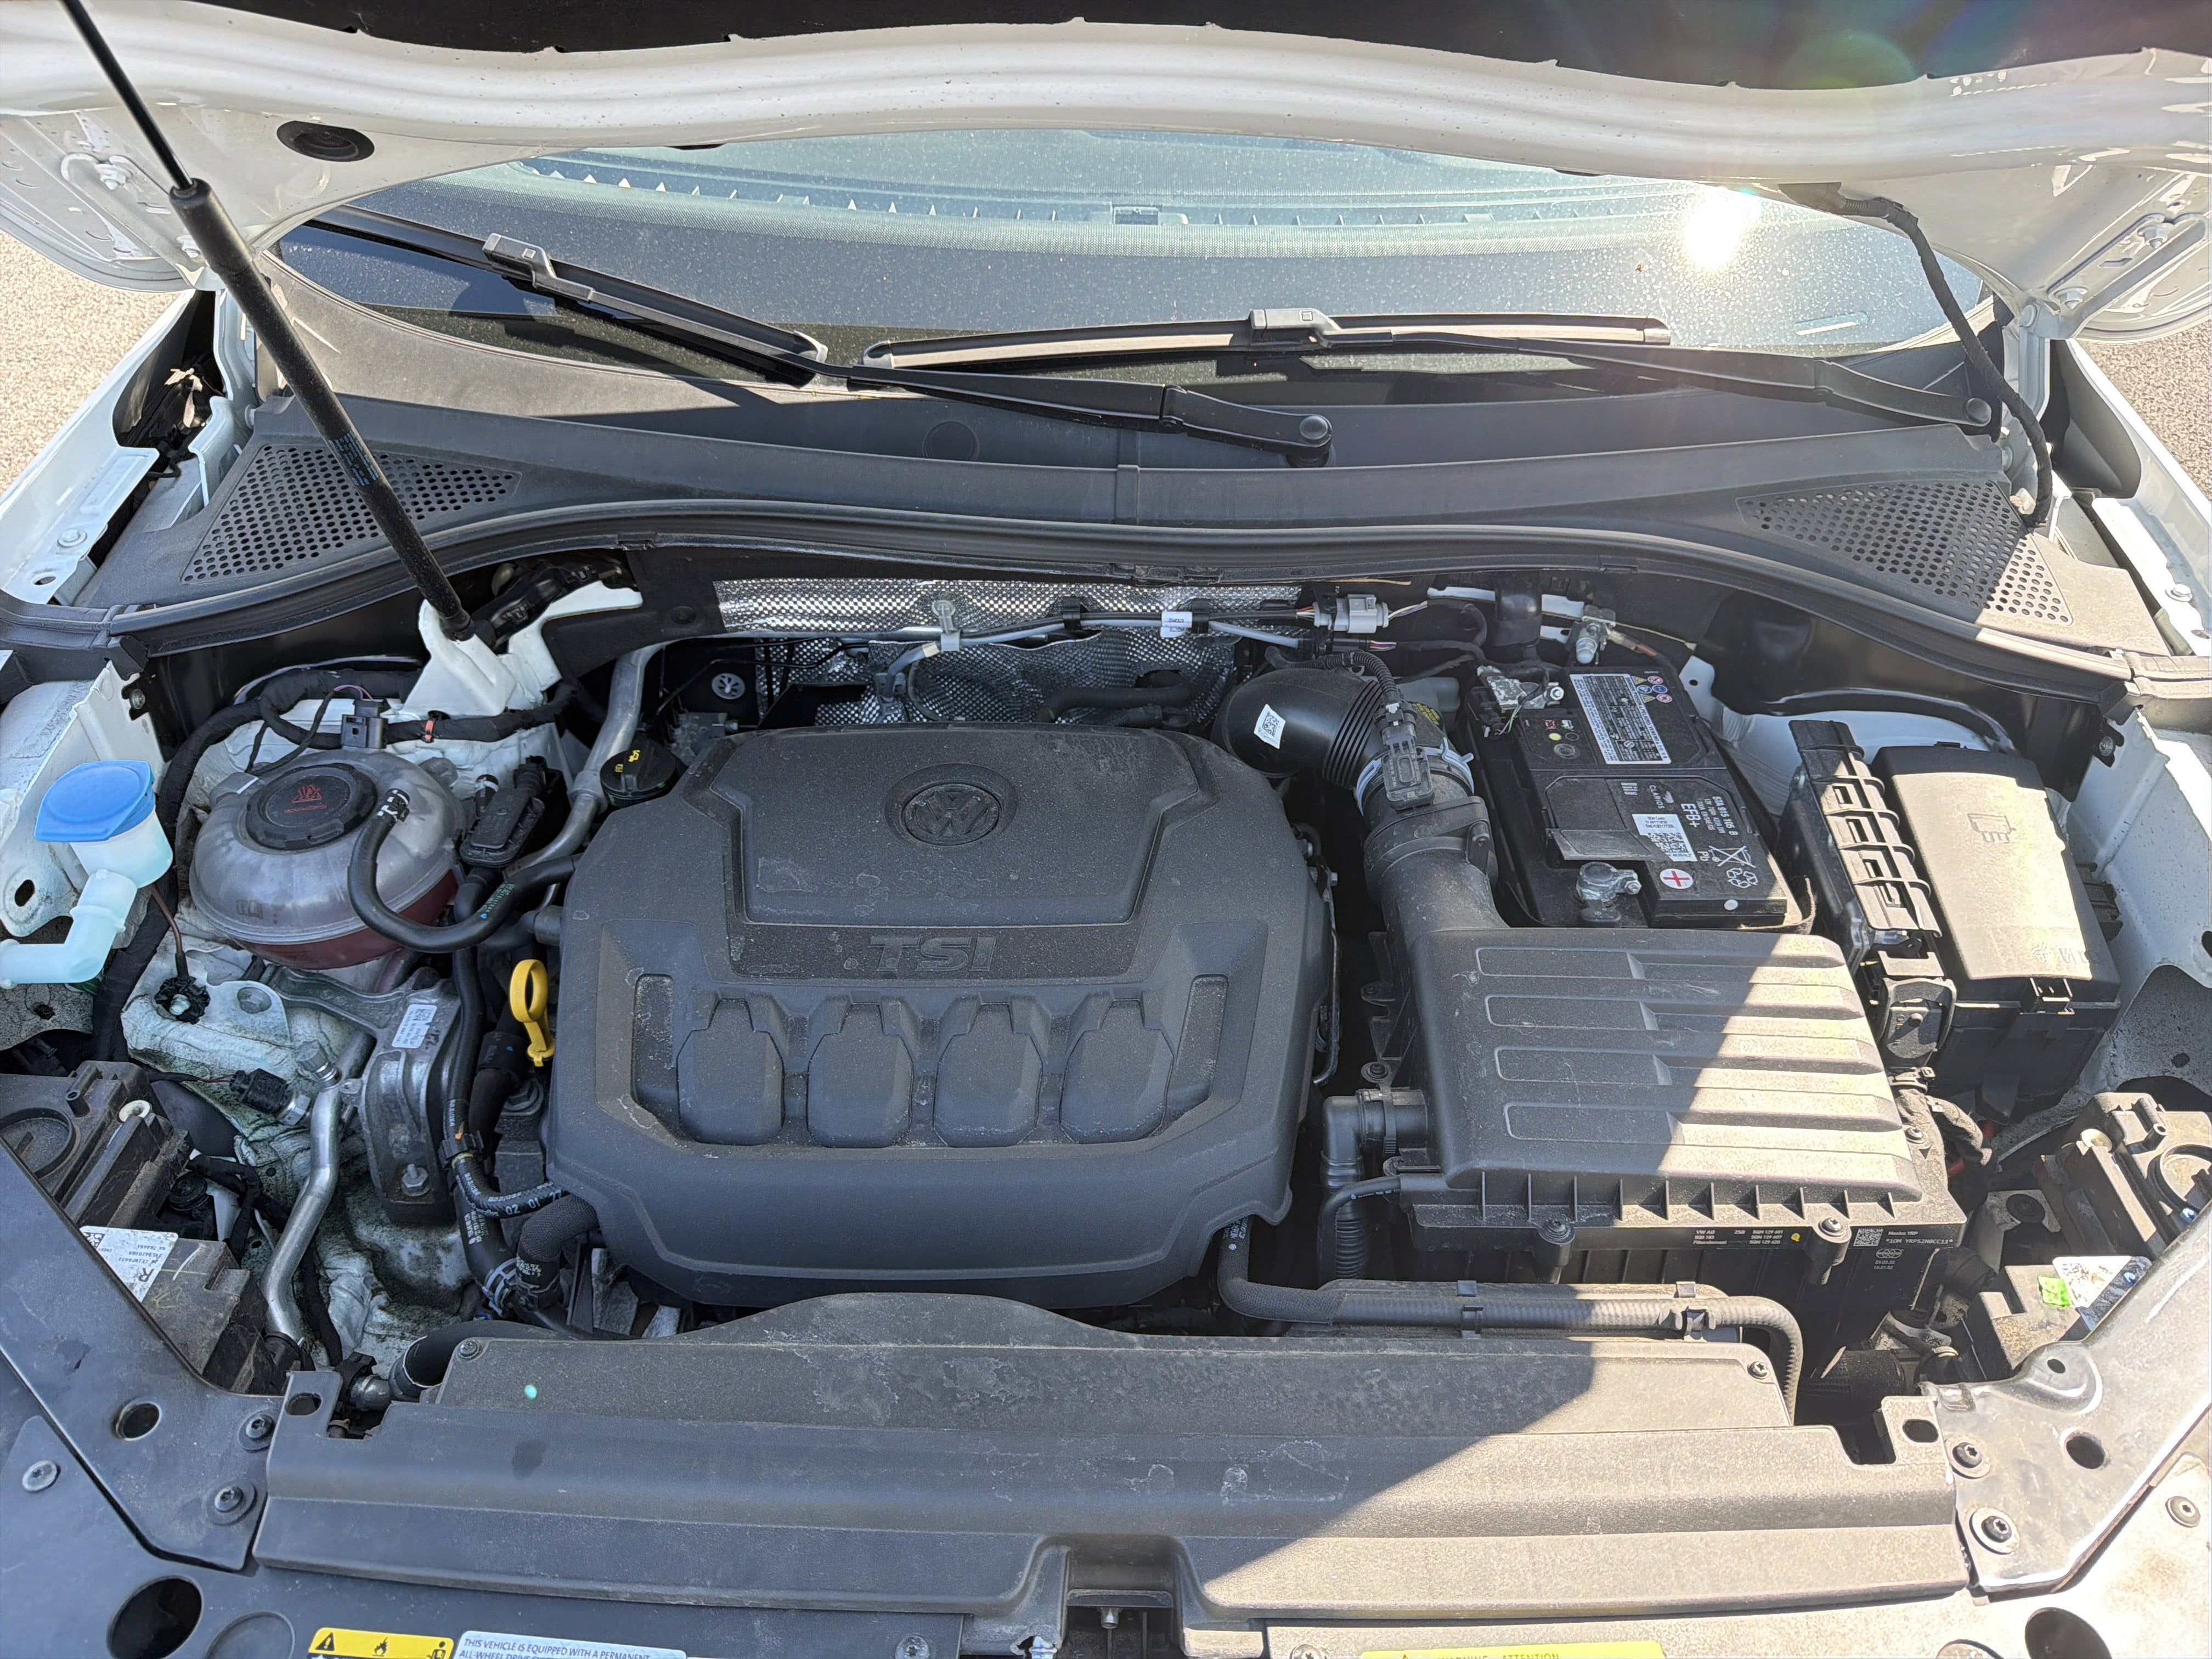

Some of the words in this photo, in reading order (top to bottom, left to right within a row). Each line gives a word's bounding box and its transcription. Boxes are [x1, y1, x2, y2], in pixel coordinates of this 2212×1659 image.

[1649, 785, 1665, 809] CLARIOS
[1712, 796, 1724, 807] 5TA
[1680, 803, 1701, 828] EFB+
[1718, 807, 1730, 817] 915
[1723, 819, 1735, 829] 105
[1697, 851, 1710, 861] Pb
[867, 935, 997, 972] TSI
[506, 1204, 520, 1215] 02
[138, 1268, 154, 1282] R
[465, 1638, 482, 1647] THIS
[484, 1640, 517, 1651] VEHICLE
[527, 1645, 568, 1655] EQUIPPED
[569, 1648, 591, 1657] WITH
[592, 1650, 599, 1658] A
[459, 1650, 504, 1659] ALL-WHEEL
